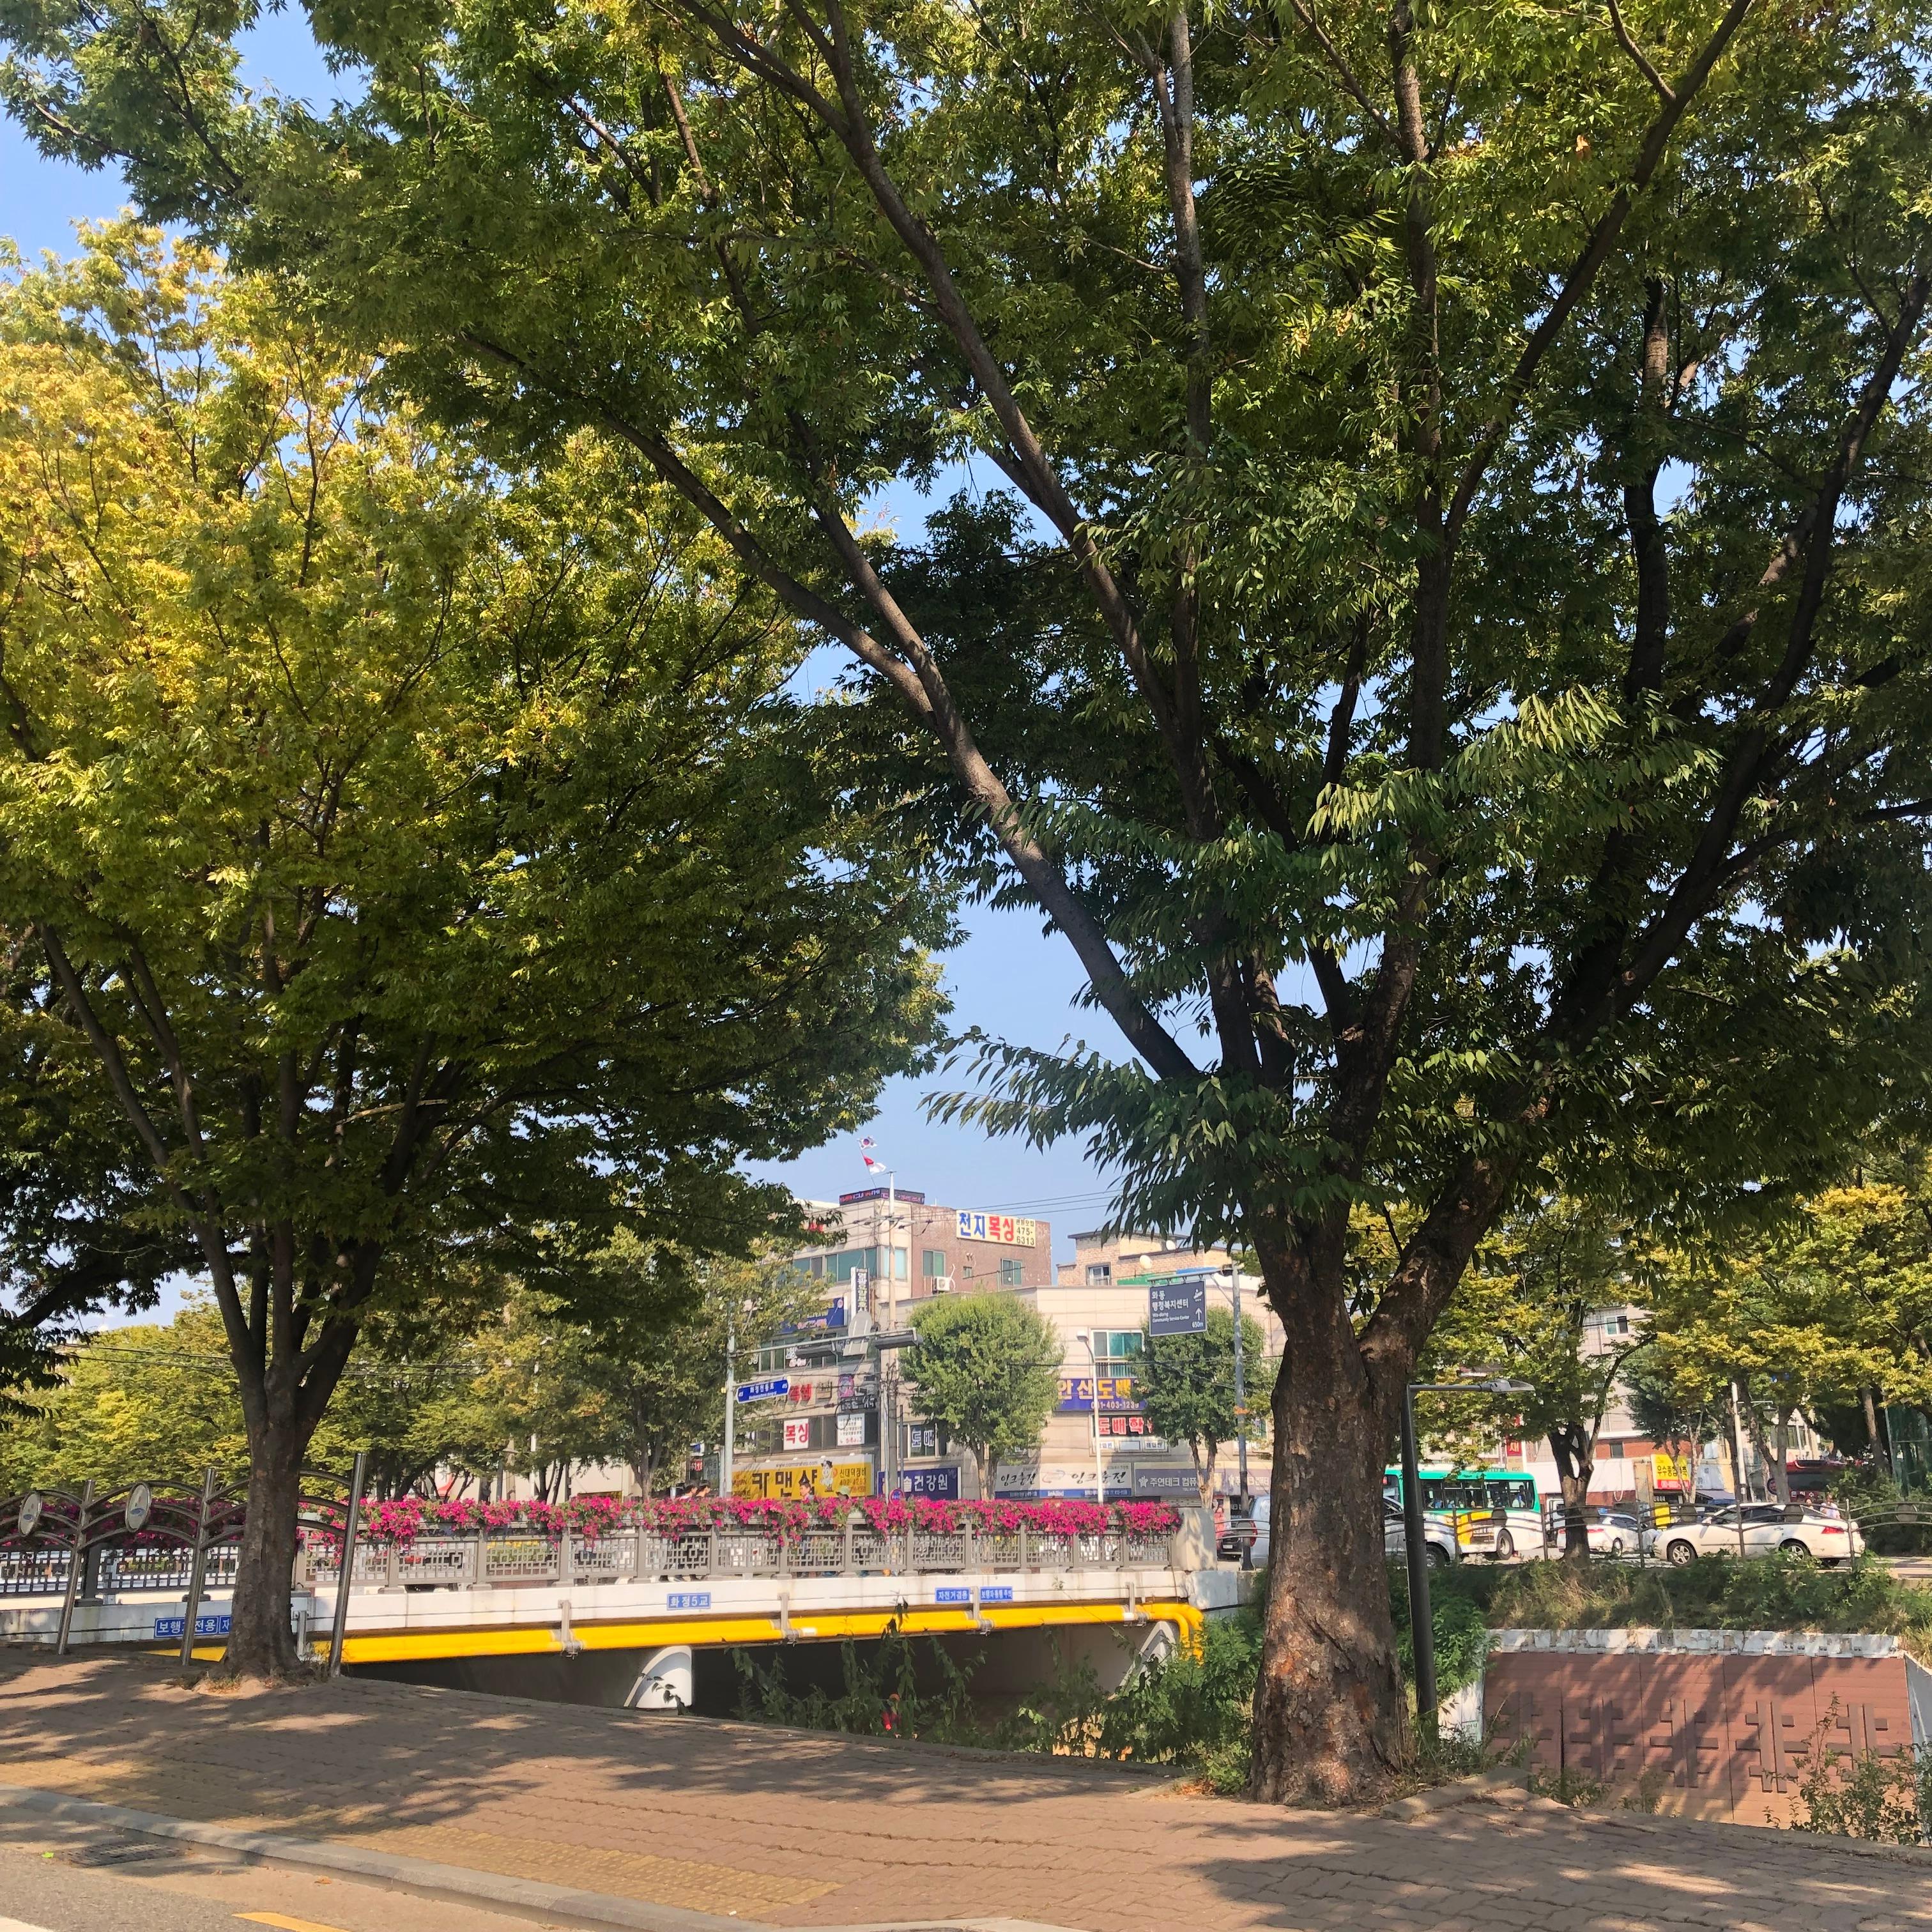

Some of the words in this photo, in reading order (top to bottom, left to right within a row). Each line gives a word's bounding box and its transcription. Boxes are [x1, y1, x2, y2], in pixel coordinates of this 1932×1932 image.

[1016, 1227, 1032, 1236] 475-
[1017, 1236, 1034, 1245] 6313
[1152, 1291, 1165, 1300] 와동
[1152, 1298, 1189, 1312] 행정복지센터
[786, 1423, 808, 1444] 복싱
[912, 1430, 935, 1447] 도배
[1150, 1476, 1180, 1487] 주연테크
[670, 1596, 708, 1607] 화정5교
[157, 1619, 216, 1634] 보행전용
